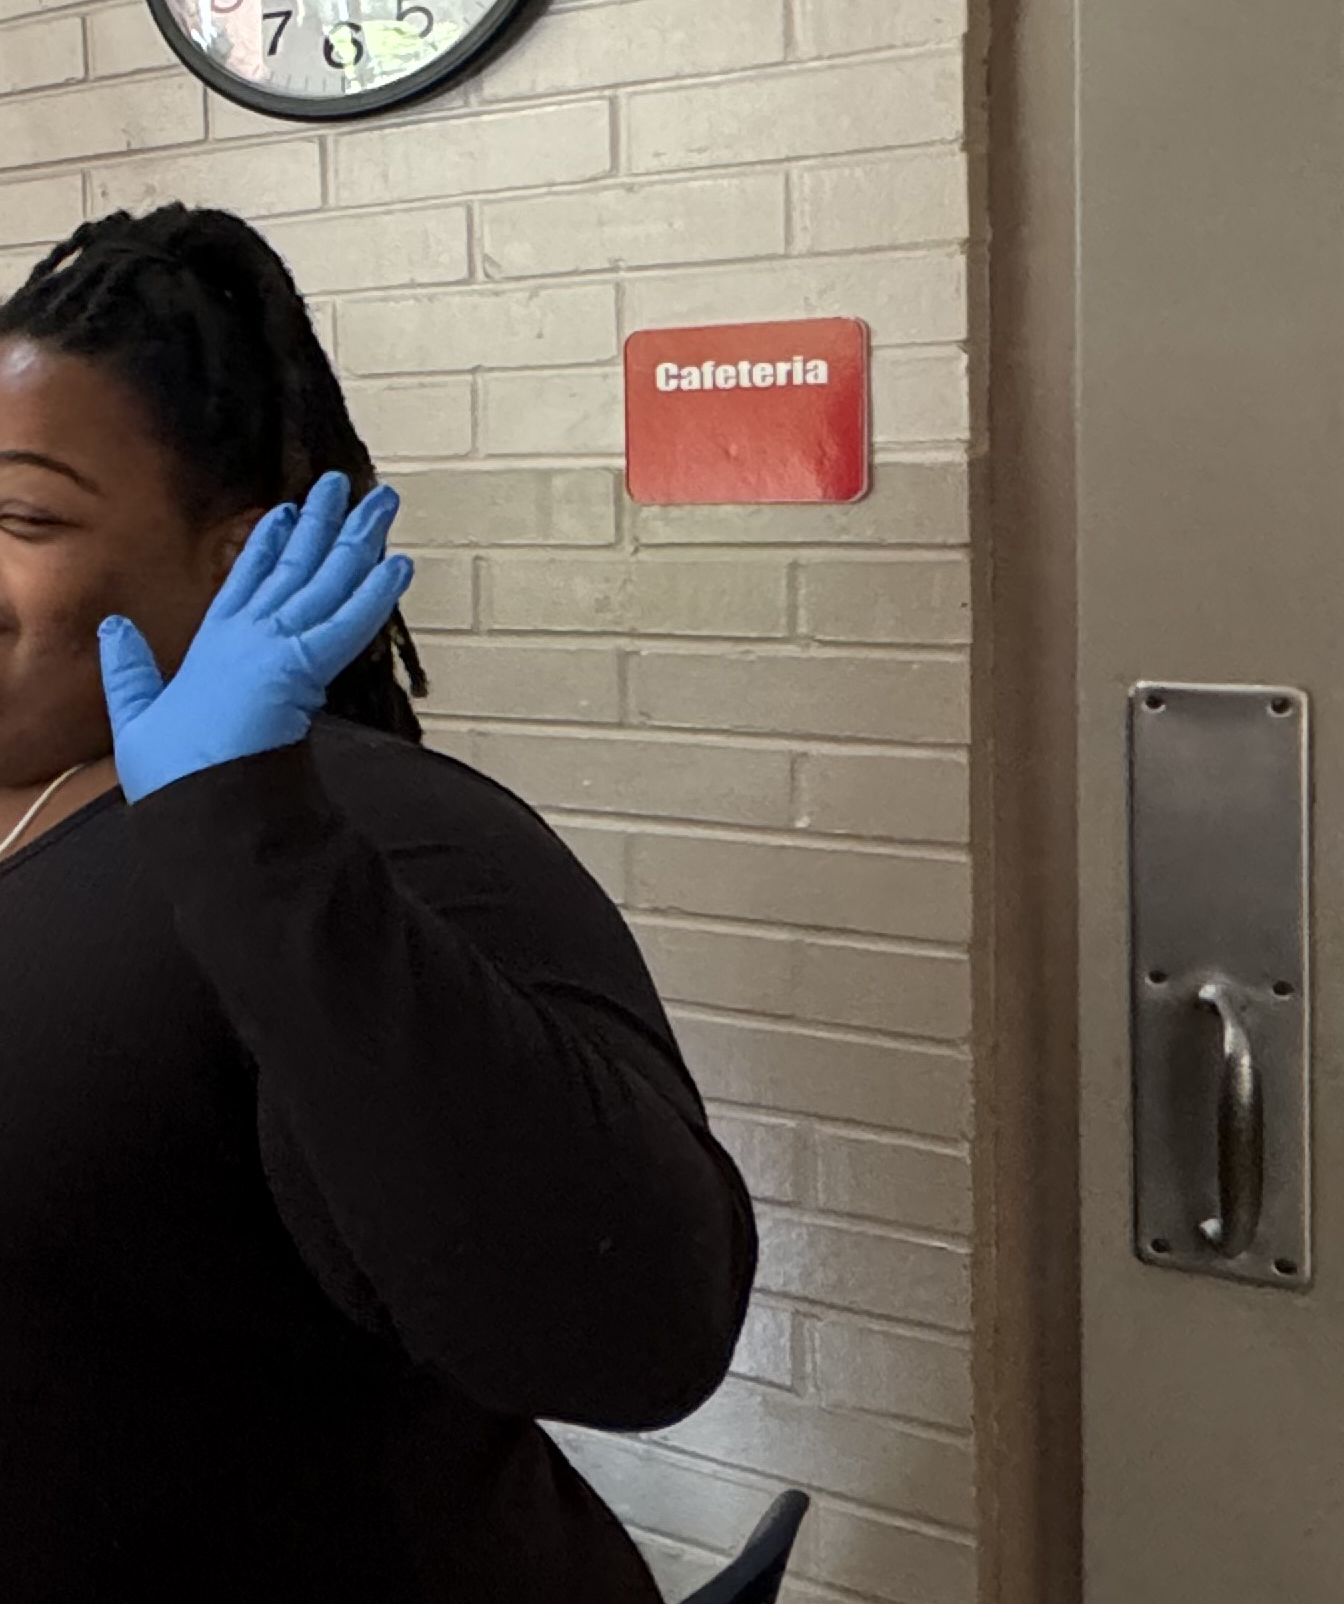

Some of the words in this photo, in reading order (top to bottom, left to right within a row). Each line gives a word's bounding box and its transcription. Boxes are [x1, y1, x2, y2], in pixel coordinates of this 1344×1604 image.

[262, 10, 293, 57] 7
[323, 21, 363, 69] 6
[655, 355, 829, 392] Cafeteria
